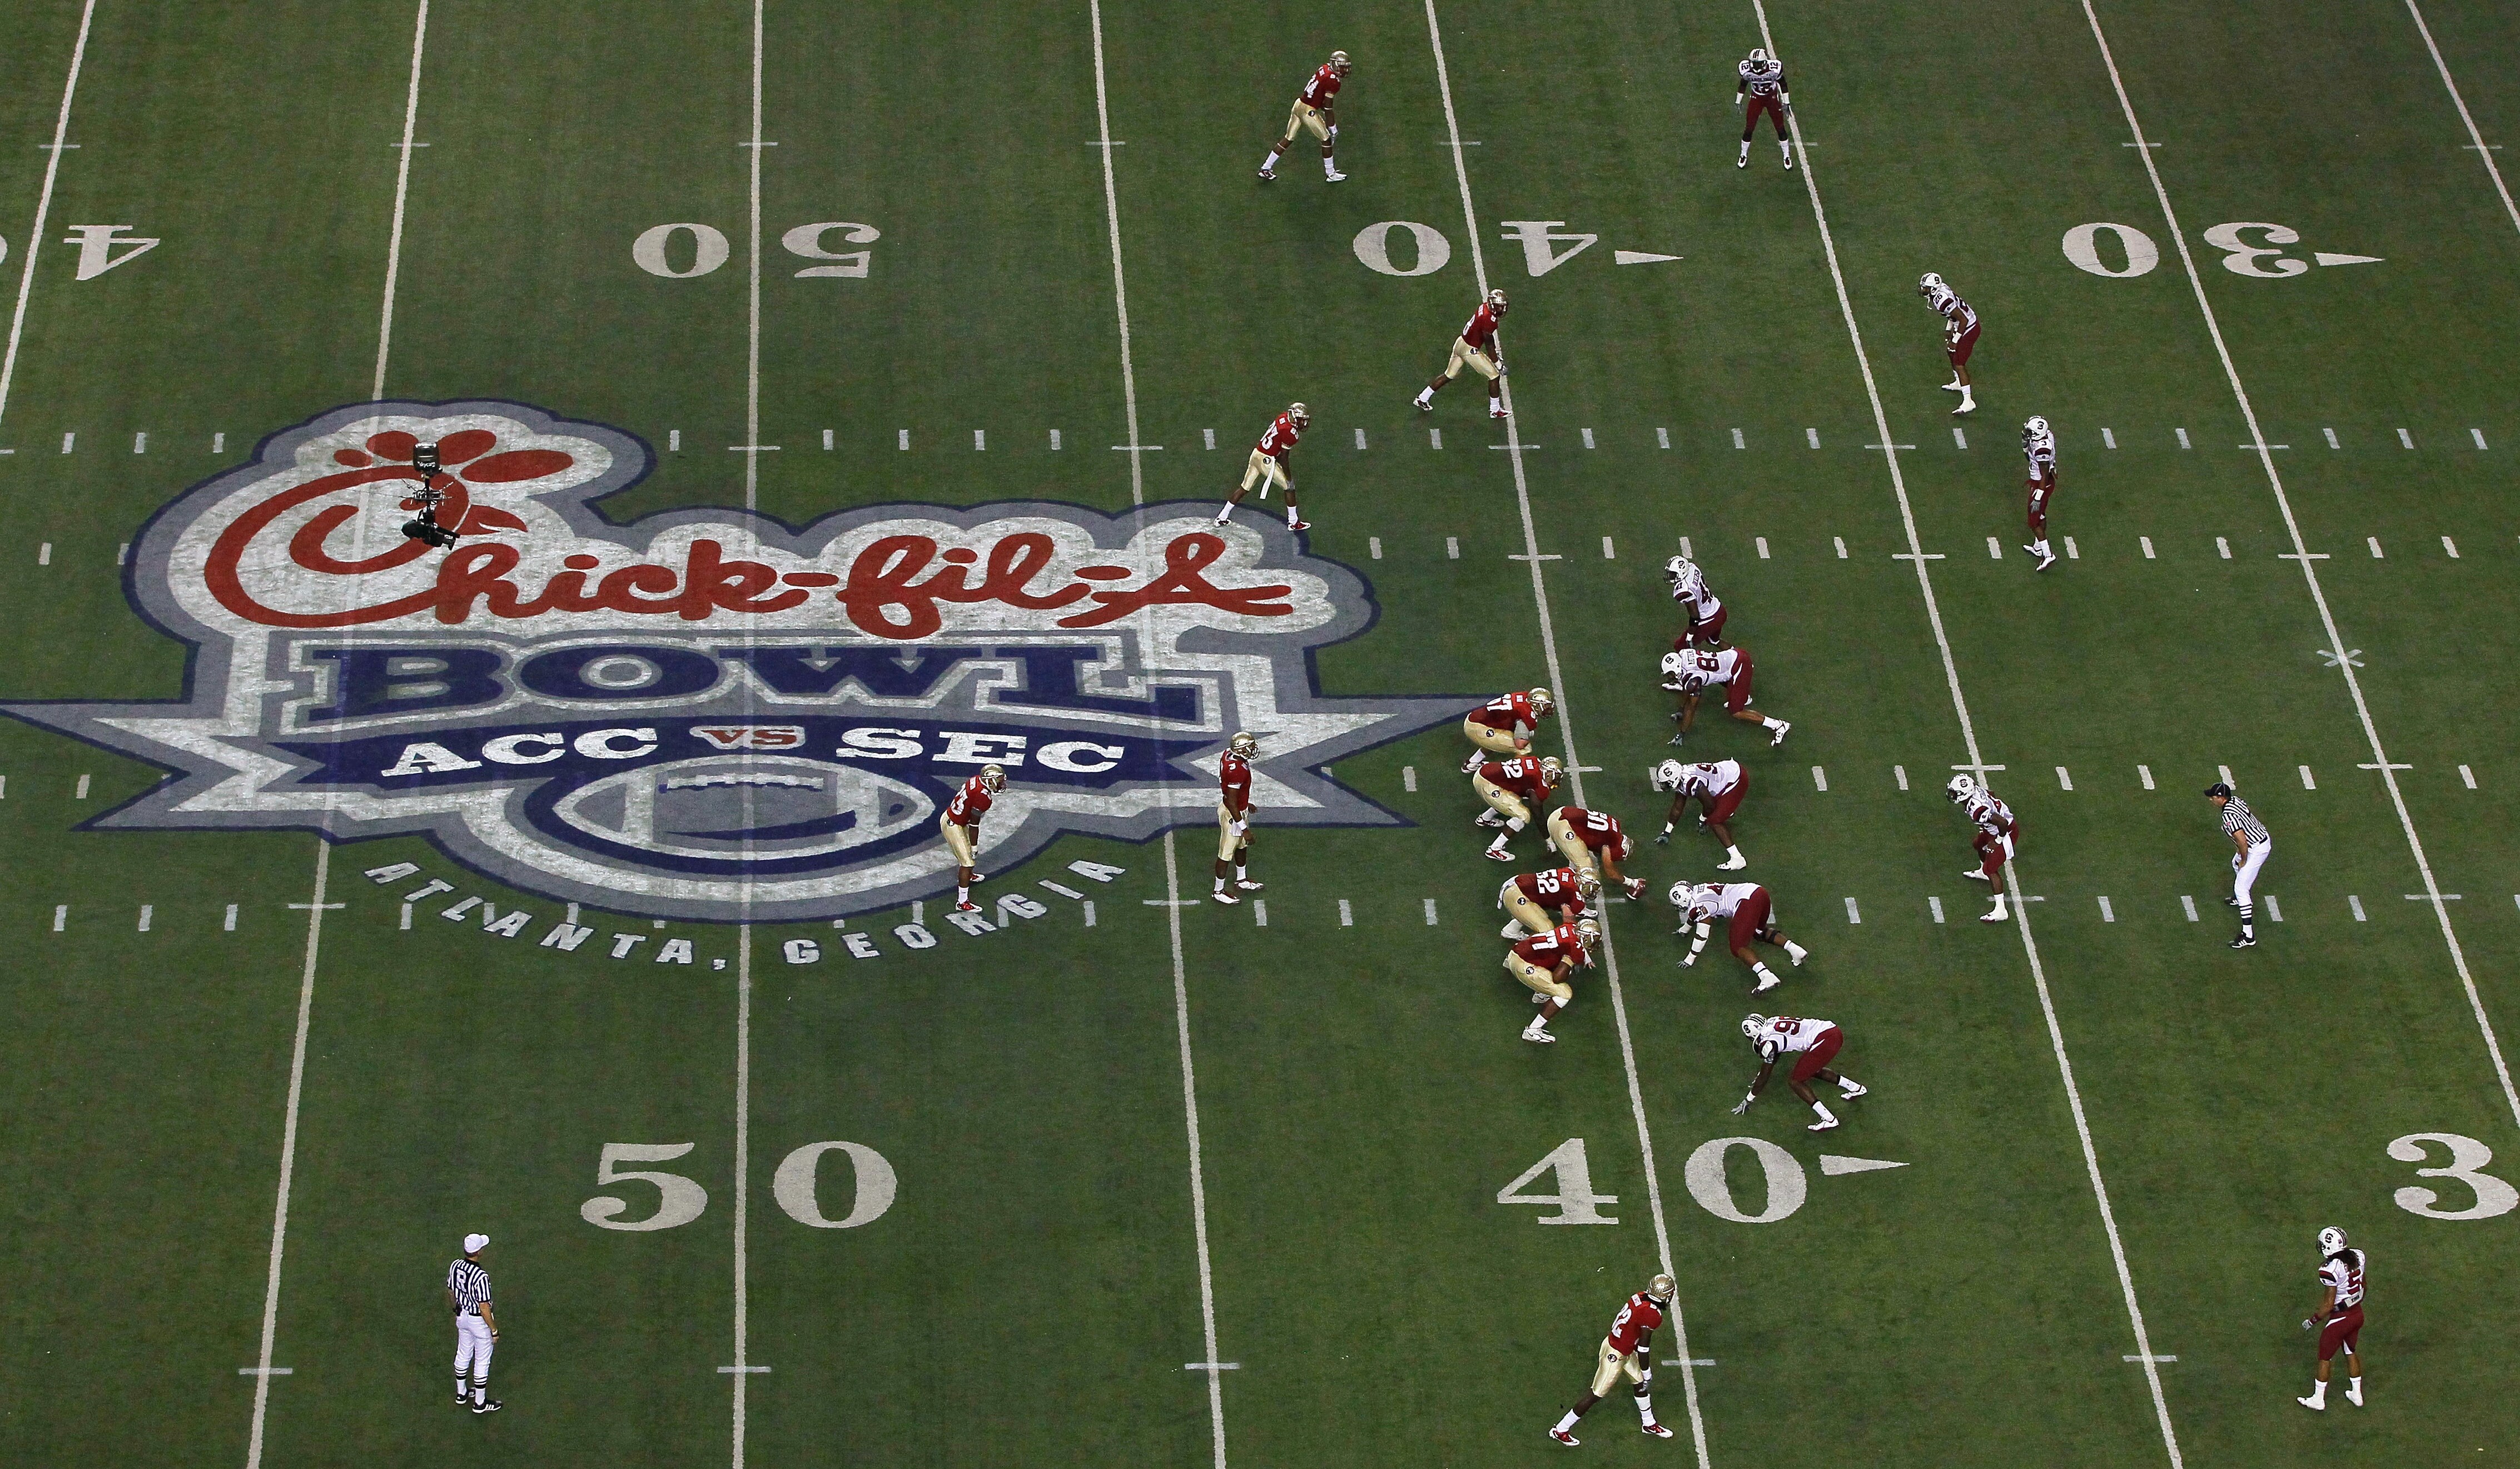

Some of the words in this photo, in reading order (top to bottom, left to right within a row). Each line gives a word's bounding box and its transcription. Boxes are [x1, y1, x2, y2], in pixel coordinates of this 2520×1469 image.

[1770, 62, 1778, 70] 12
[1934, 292, 1943, 305] 26
[205, 465, 1294, 639] Chick-fil-A
[308, 646, 1197, 721] BOWL
[381, 727, 658, 777] ACC
[836, 727, 1125, 773] SEC
[364, 861, 727, 971] ATLANTA,
[783, 860, 1126, 965] GEORGIA
[1535, 869, 1560, 894] 52
[581, 1140, 898, 1231] 50
[1497, 1136, 1807, 1225] 40
[2387, 1132, 2520, 1220] 3
[456, 1268, 468, 1293] R
